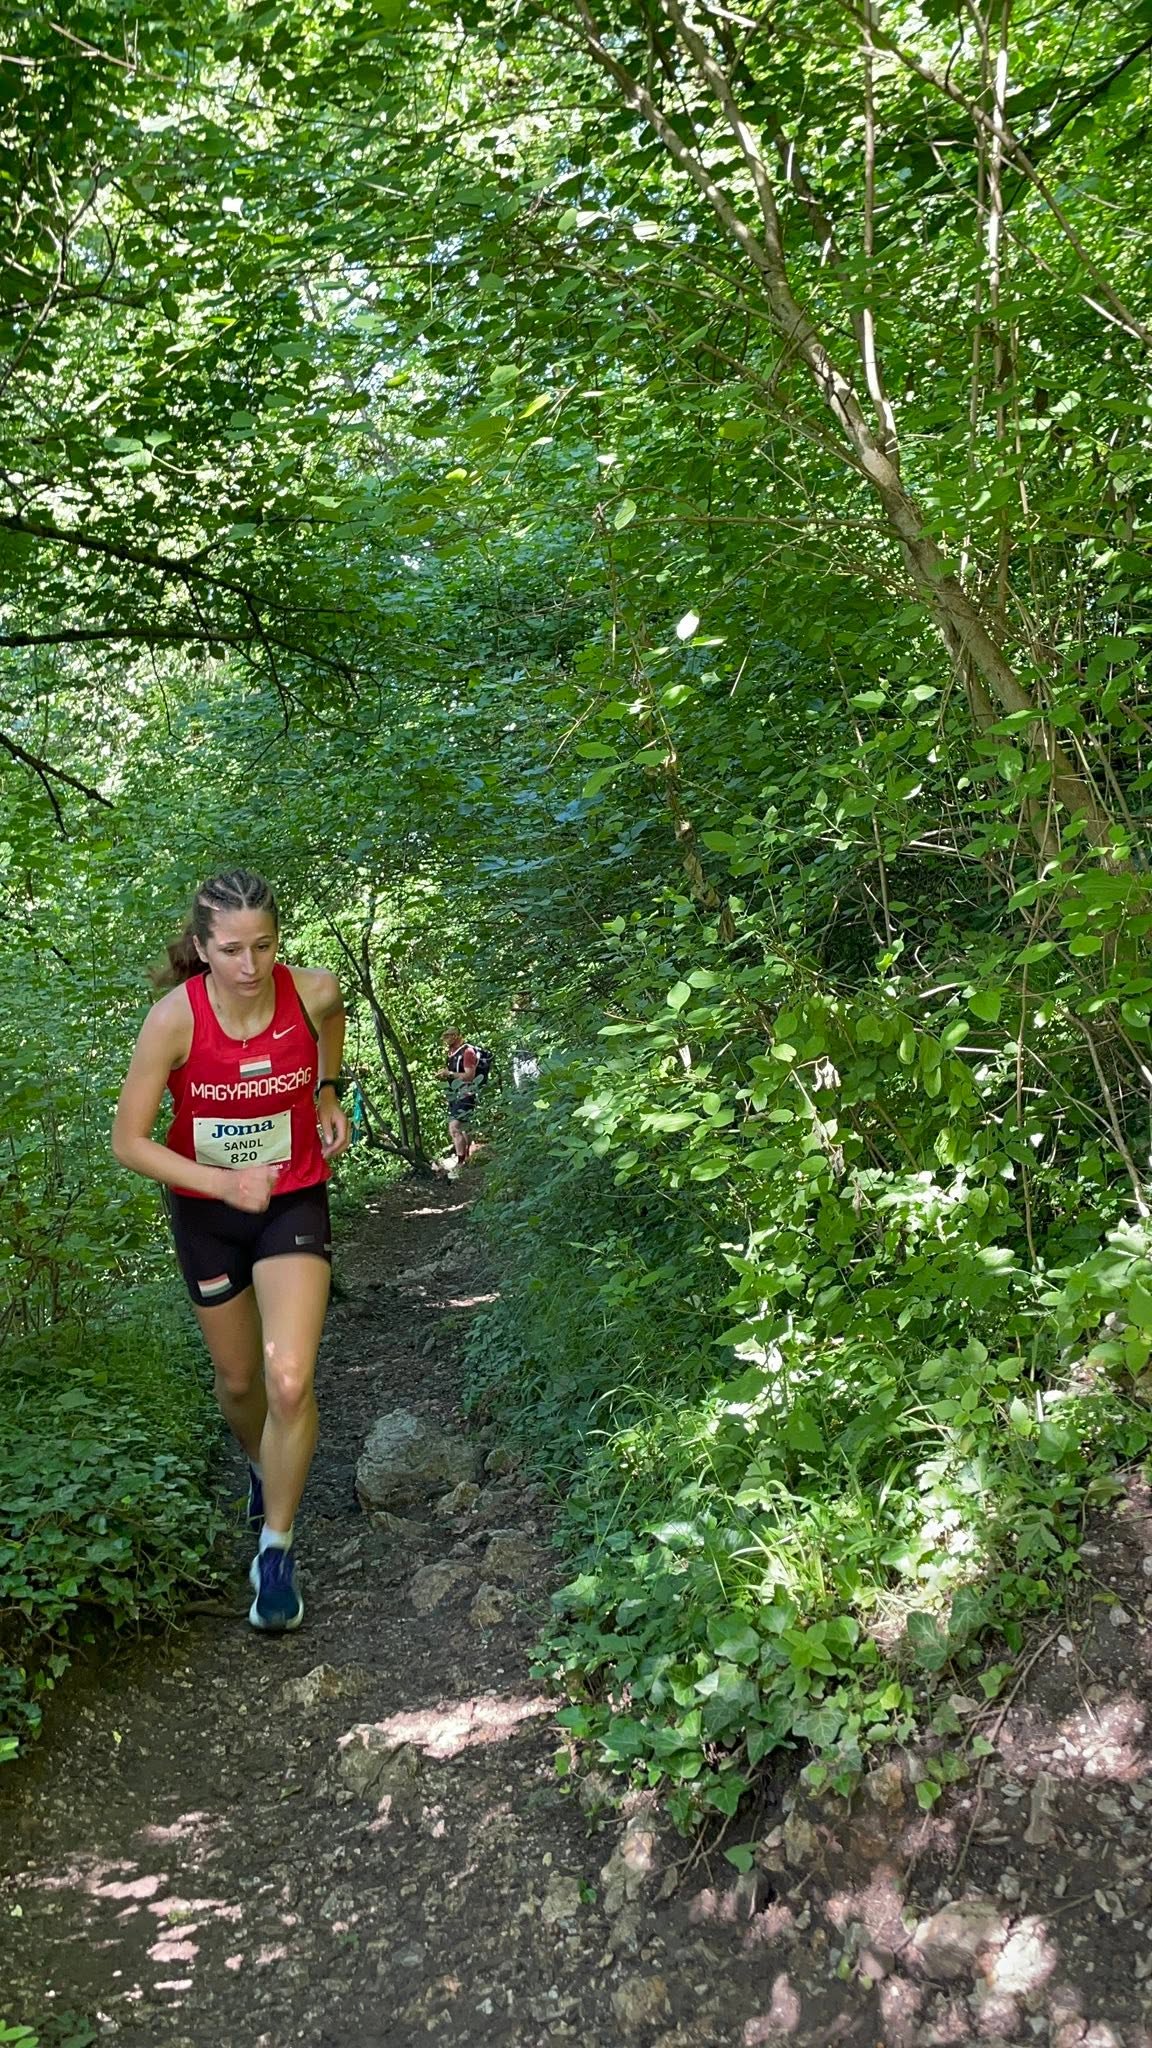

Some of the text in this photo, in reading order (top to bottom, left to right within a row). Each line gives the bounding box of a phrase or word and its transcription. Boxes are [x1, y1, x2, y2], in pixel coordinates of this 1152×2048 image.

[191, 1067, 312, 1101] MAGYARORSZÁG
[212, 1120, 275, 1139] Joma
[224, 1139, 263, 1151] SANDL
[231, 1151, 258, 1164] 820
